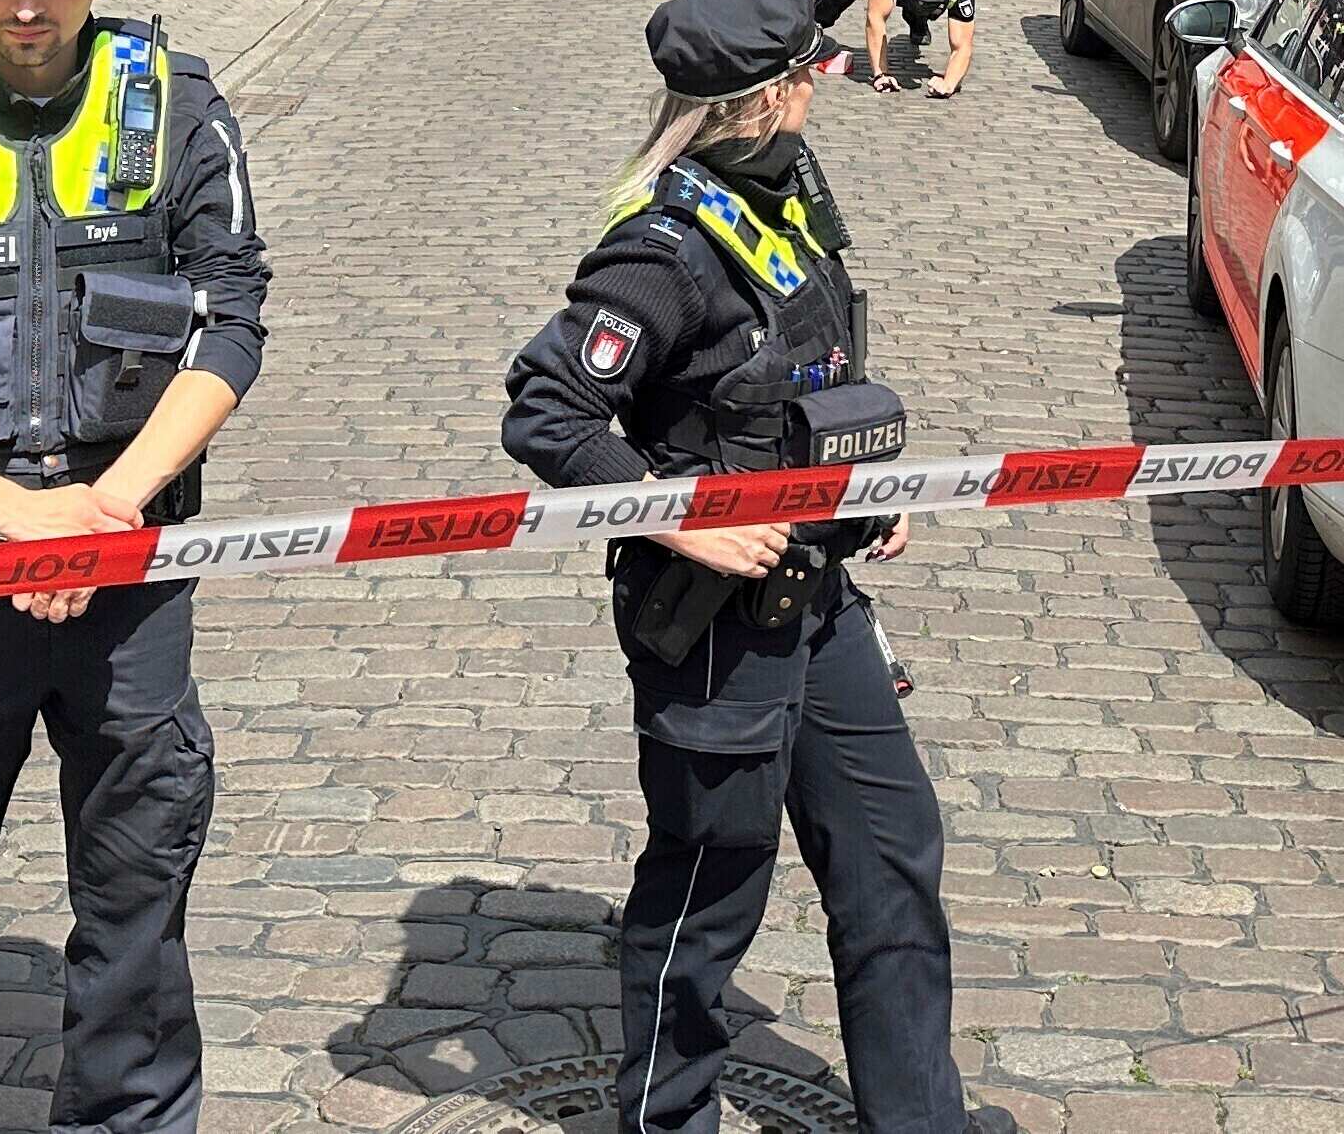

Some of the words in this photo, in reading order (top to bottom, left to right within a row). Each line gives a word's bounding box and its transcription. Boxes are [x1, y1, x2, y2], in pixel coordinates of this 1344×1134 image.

[85, 222, 118, 241] Tayé
[597, 313, 640, 342] POLIZEI
[822, 420, 903, 461] POLIZEI
